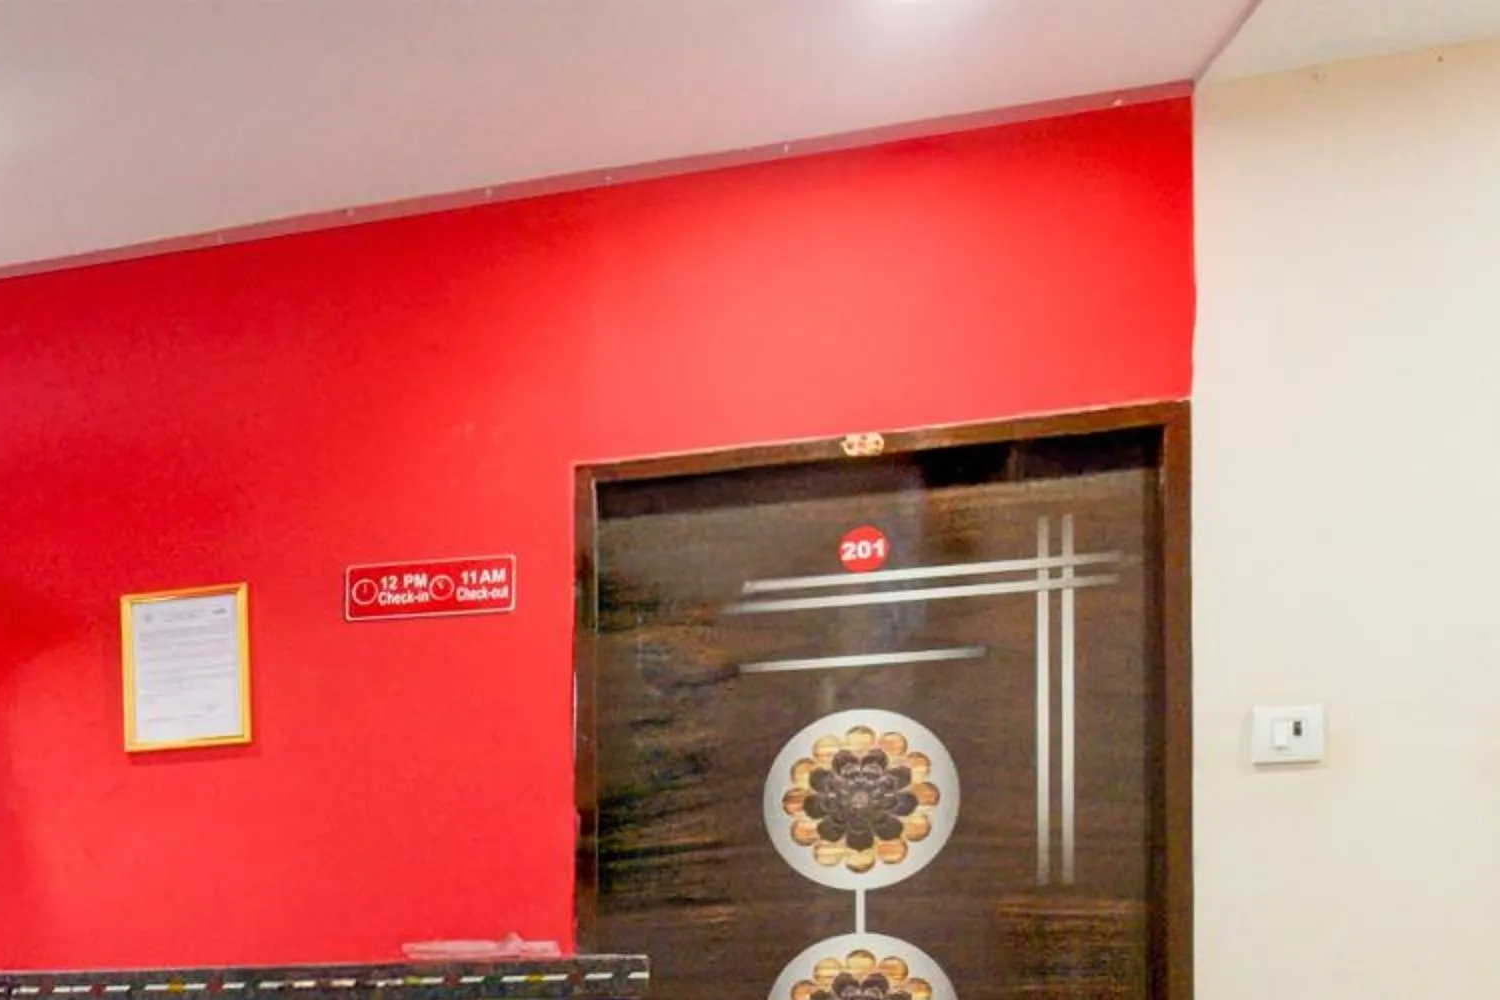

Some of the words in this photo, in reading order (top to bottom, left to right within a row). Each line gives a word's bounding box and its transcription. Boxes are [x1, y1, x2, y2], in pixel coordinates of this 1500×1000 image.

[840, 538, 885, 561] 201
[380, 575, 398, 591] 12
[403, 571, 428, 589] PM
[378, 589, 430, 606] Check-in
